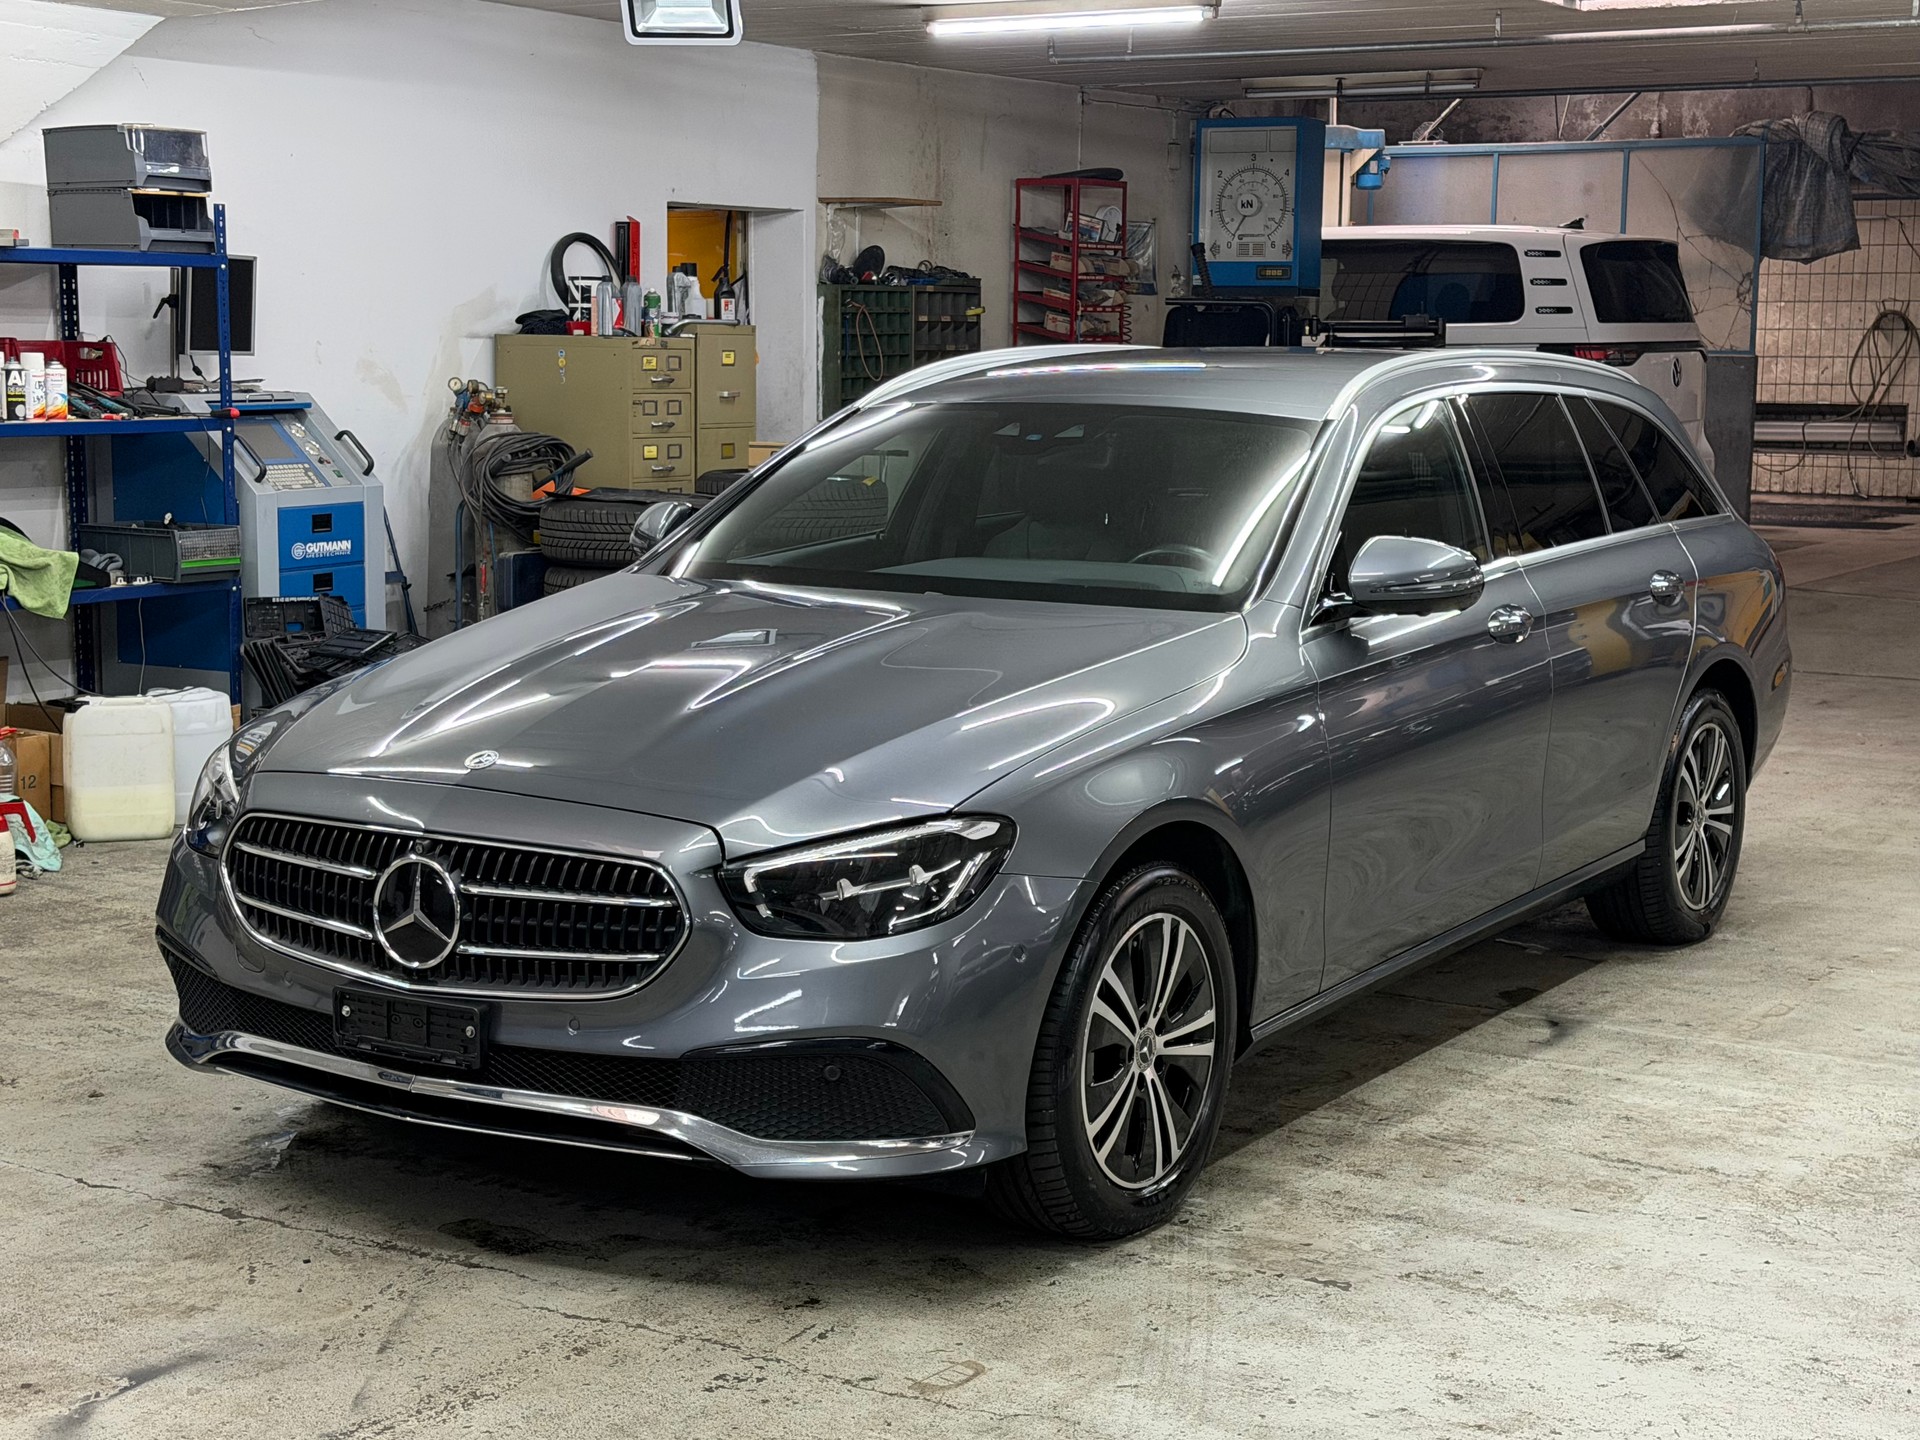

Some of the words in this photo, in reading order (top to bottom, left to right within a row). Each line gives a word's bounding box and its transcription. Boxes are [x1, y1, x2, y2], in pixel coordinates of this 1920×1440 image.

[1217, 170, 1223, 178] 2
[1240, 199, 1253, 208] kN
[1209, 209, 1213, 217] 1
[1226, 241, 1232, 249] 0
[1270, 241, 1276, 249] 6
[306, 540, 351, 553] GUTMANN
[20, 775, 37, 790] 12
